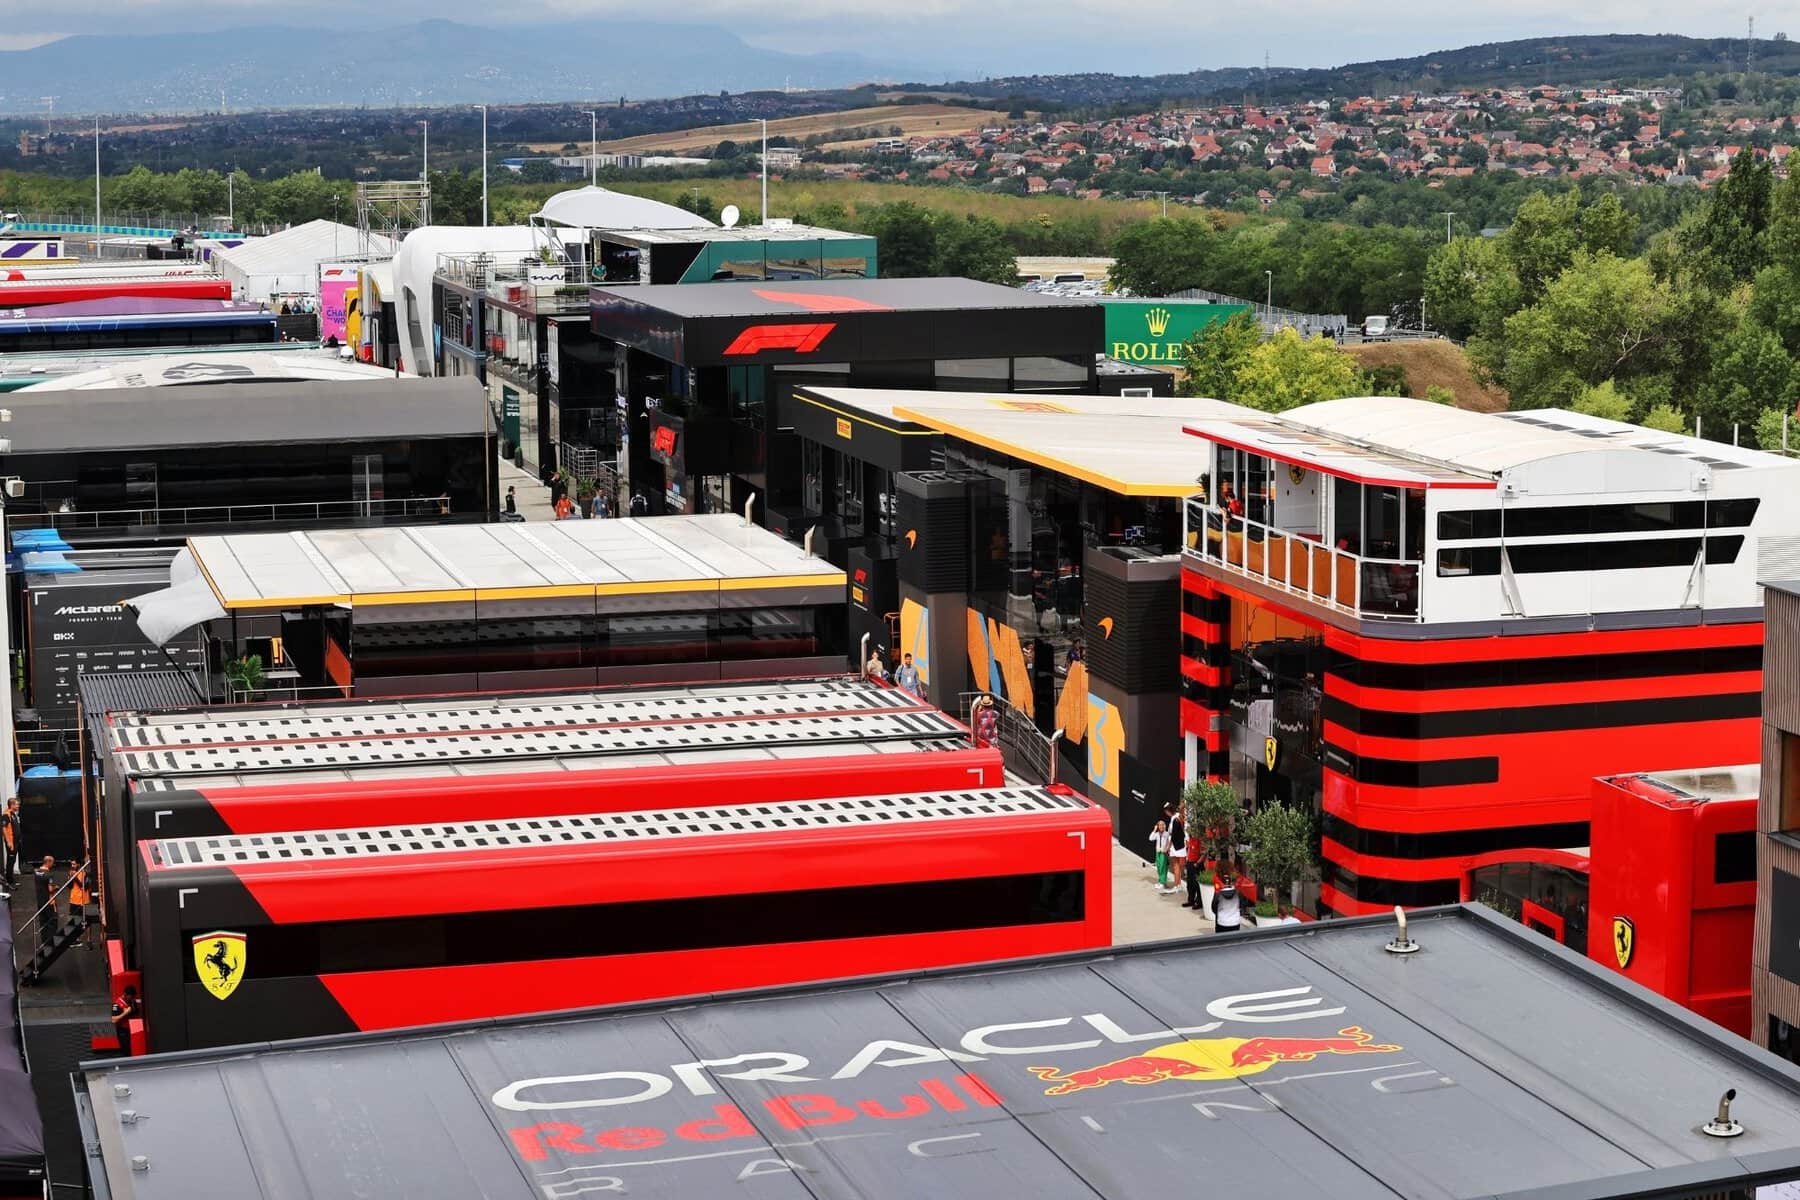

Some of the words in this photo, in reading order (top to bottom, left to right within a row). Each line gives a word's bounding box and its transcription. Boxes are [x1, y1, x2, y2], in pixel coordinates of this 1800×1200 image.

[723, 323, 838, 355] F1
[1112, 342, 1188, 360] ROLE
[54, 605, 122, 616] McLaren
[53, 632, 75, 641] OKX
[491, 985, 1347, 1112] ORACLE
[509, 1103, 757, 1161] Red
[762, 1072, 1004, 1132] Bull
